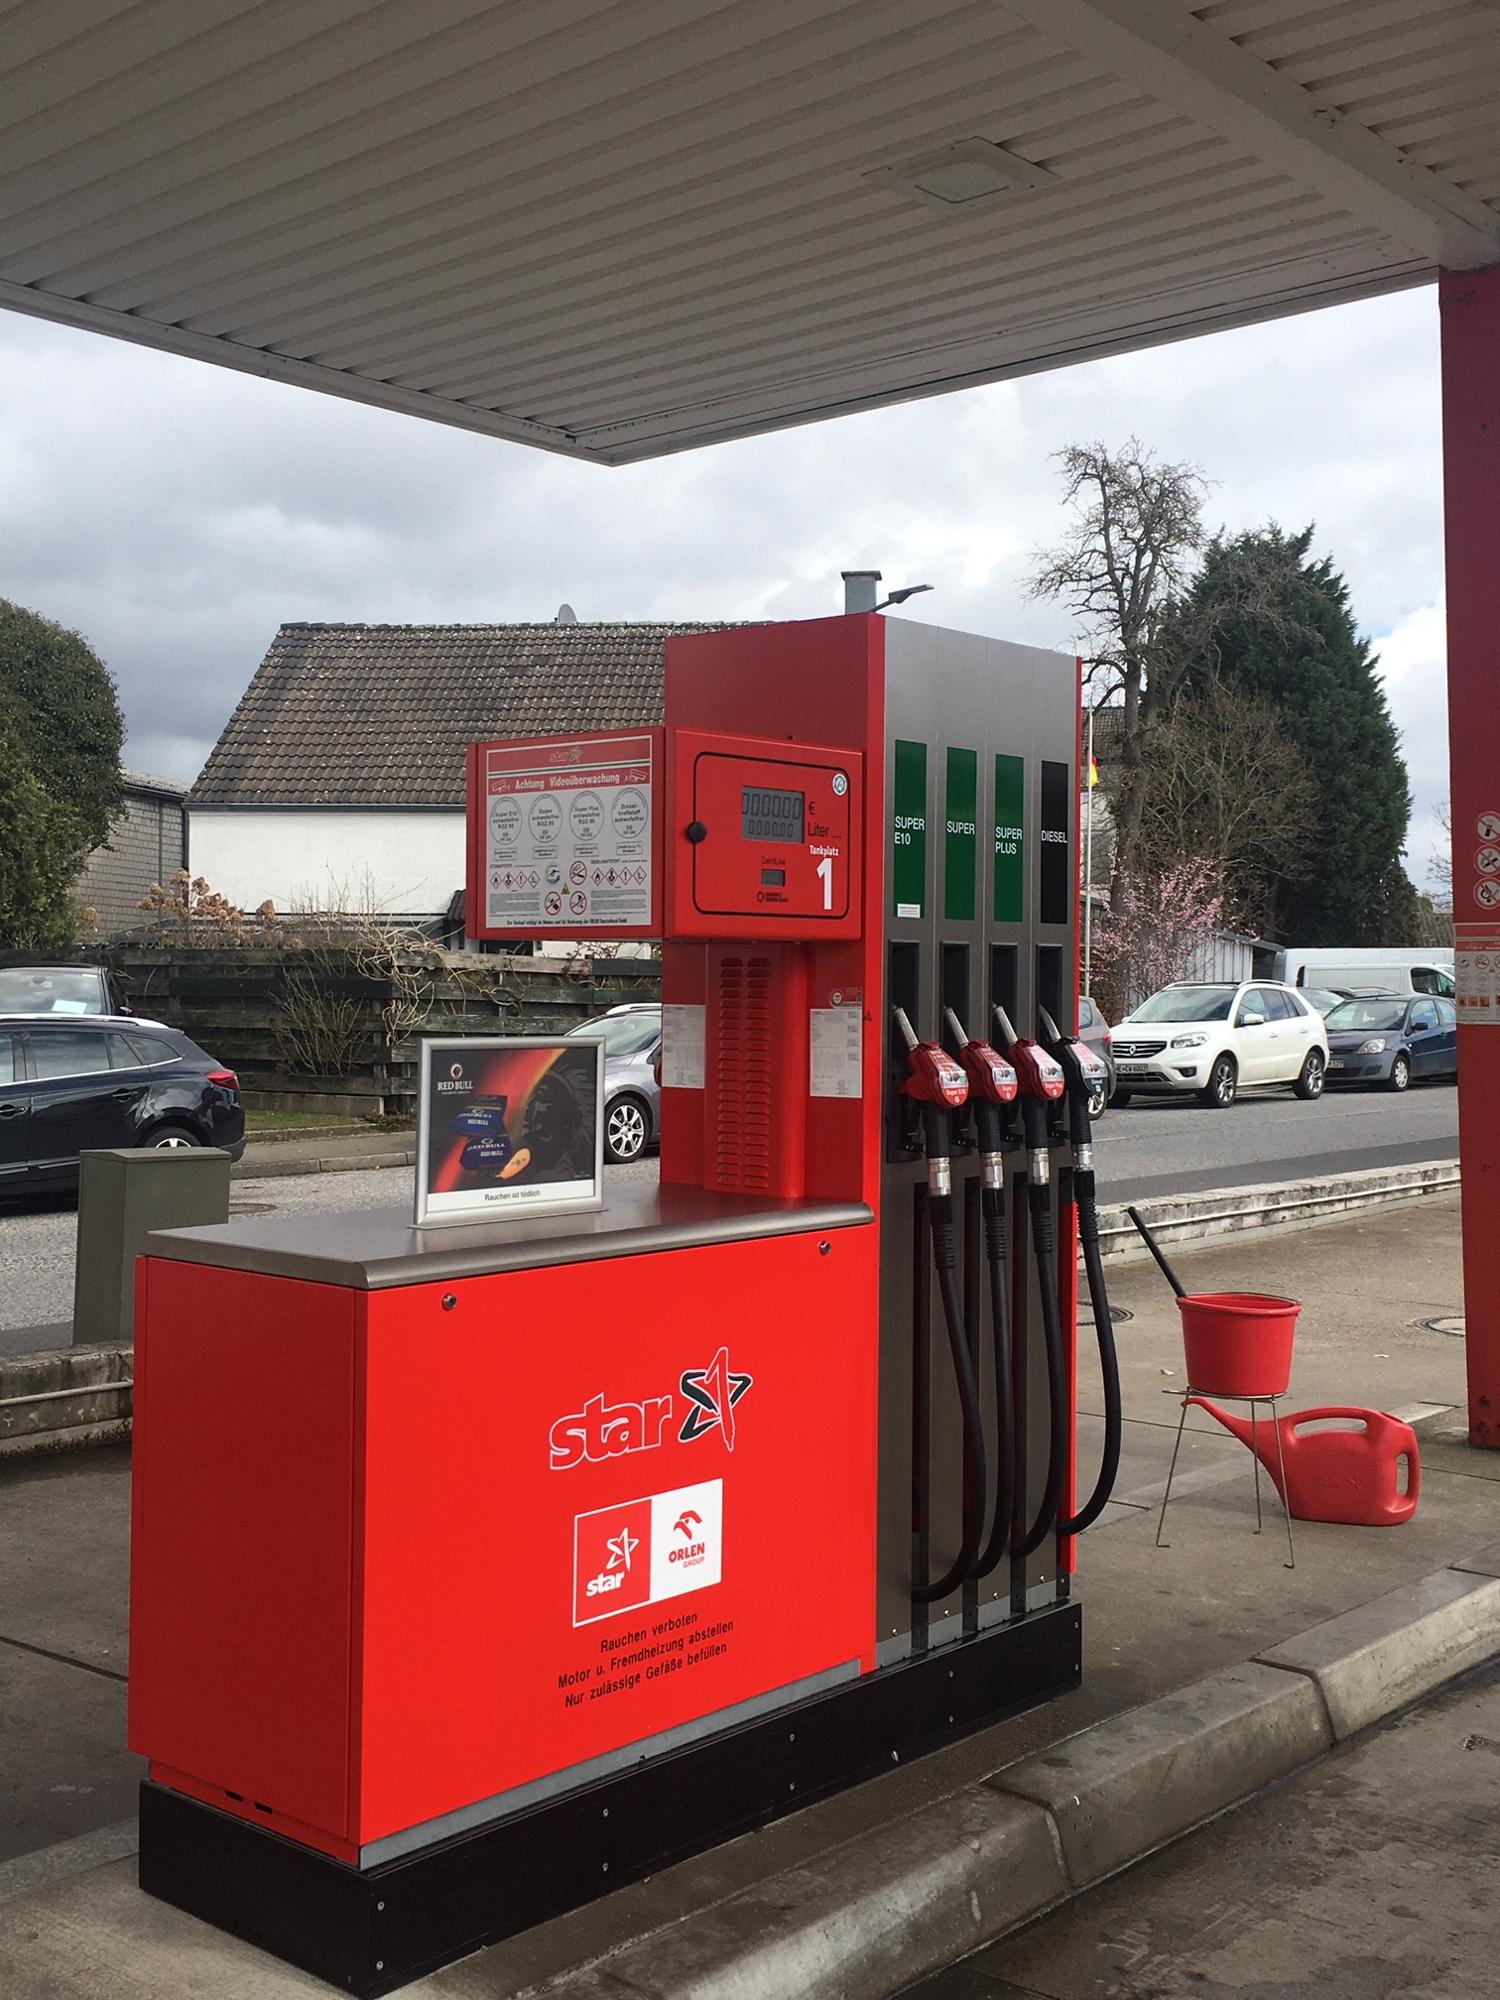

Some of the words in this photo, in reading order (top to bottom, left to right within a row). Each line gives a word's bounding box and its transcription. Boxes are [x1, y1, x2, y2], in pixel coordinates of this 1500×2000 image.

[515, 779, 544, 790] Achtung
[549, 773, 620, 787] Videoüberwachung
[808, 801, 816, 815] €
[807, 822, 829, 836] Liter
[895, 816, 925, 831] SUPER
[947, 821, 975, 835] SUPER
[894, 832, 911, 845] E10
[995, 826, 1023, 840] SUPER
[1041, 830, 1068, 843] DIESEL
[809, 845, 839, 857] Tankplatz
[995, 843, 1017, 855] PLUS
[816, 858, 832, 910] 1
[437, 1081, 454, 1091] RED
[455, 1081, 473, 1090] BULL
[550, 1392, 672, 1470] star
[668, 1542, 705, 1563] ORLEN
[683, 1556, 705, 1568] GROUP
[586, 1571, 625, 1597] star
[601, 1629, 647, 1653] Rauchen
[652, 1613, 698, 1637] verboten
[558, 1668, 591, 1689] Motor
[596, 1664, 605, 1676] u.
[610, 1638, 684, 1671] Fremdheizung
[688, 1620, 734, 1644] abstellen
[565, 1693, 584, 1708] Nur
[590, 1672, 641, 1700] zulässige
[646, 1659, 683, 1679] Gefäße
[687, 1643, 727, 1666] befüllen
